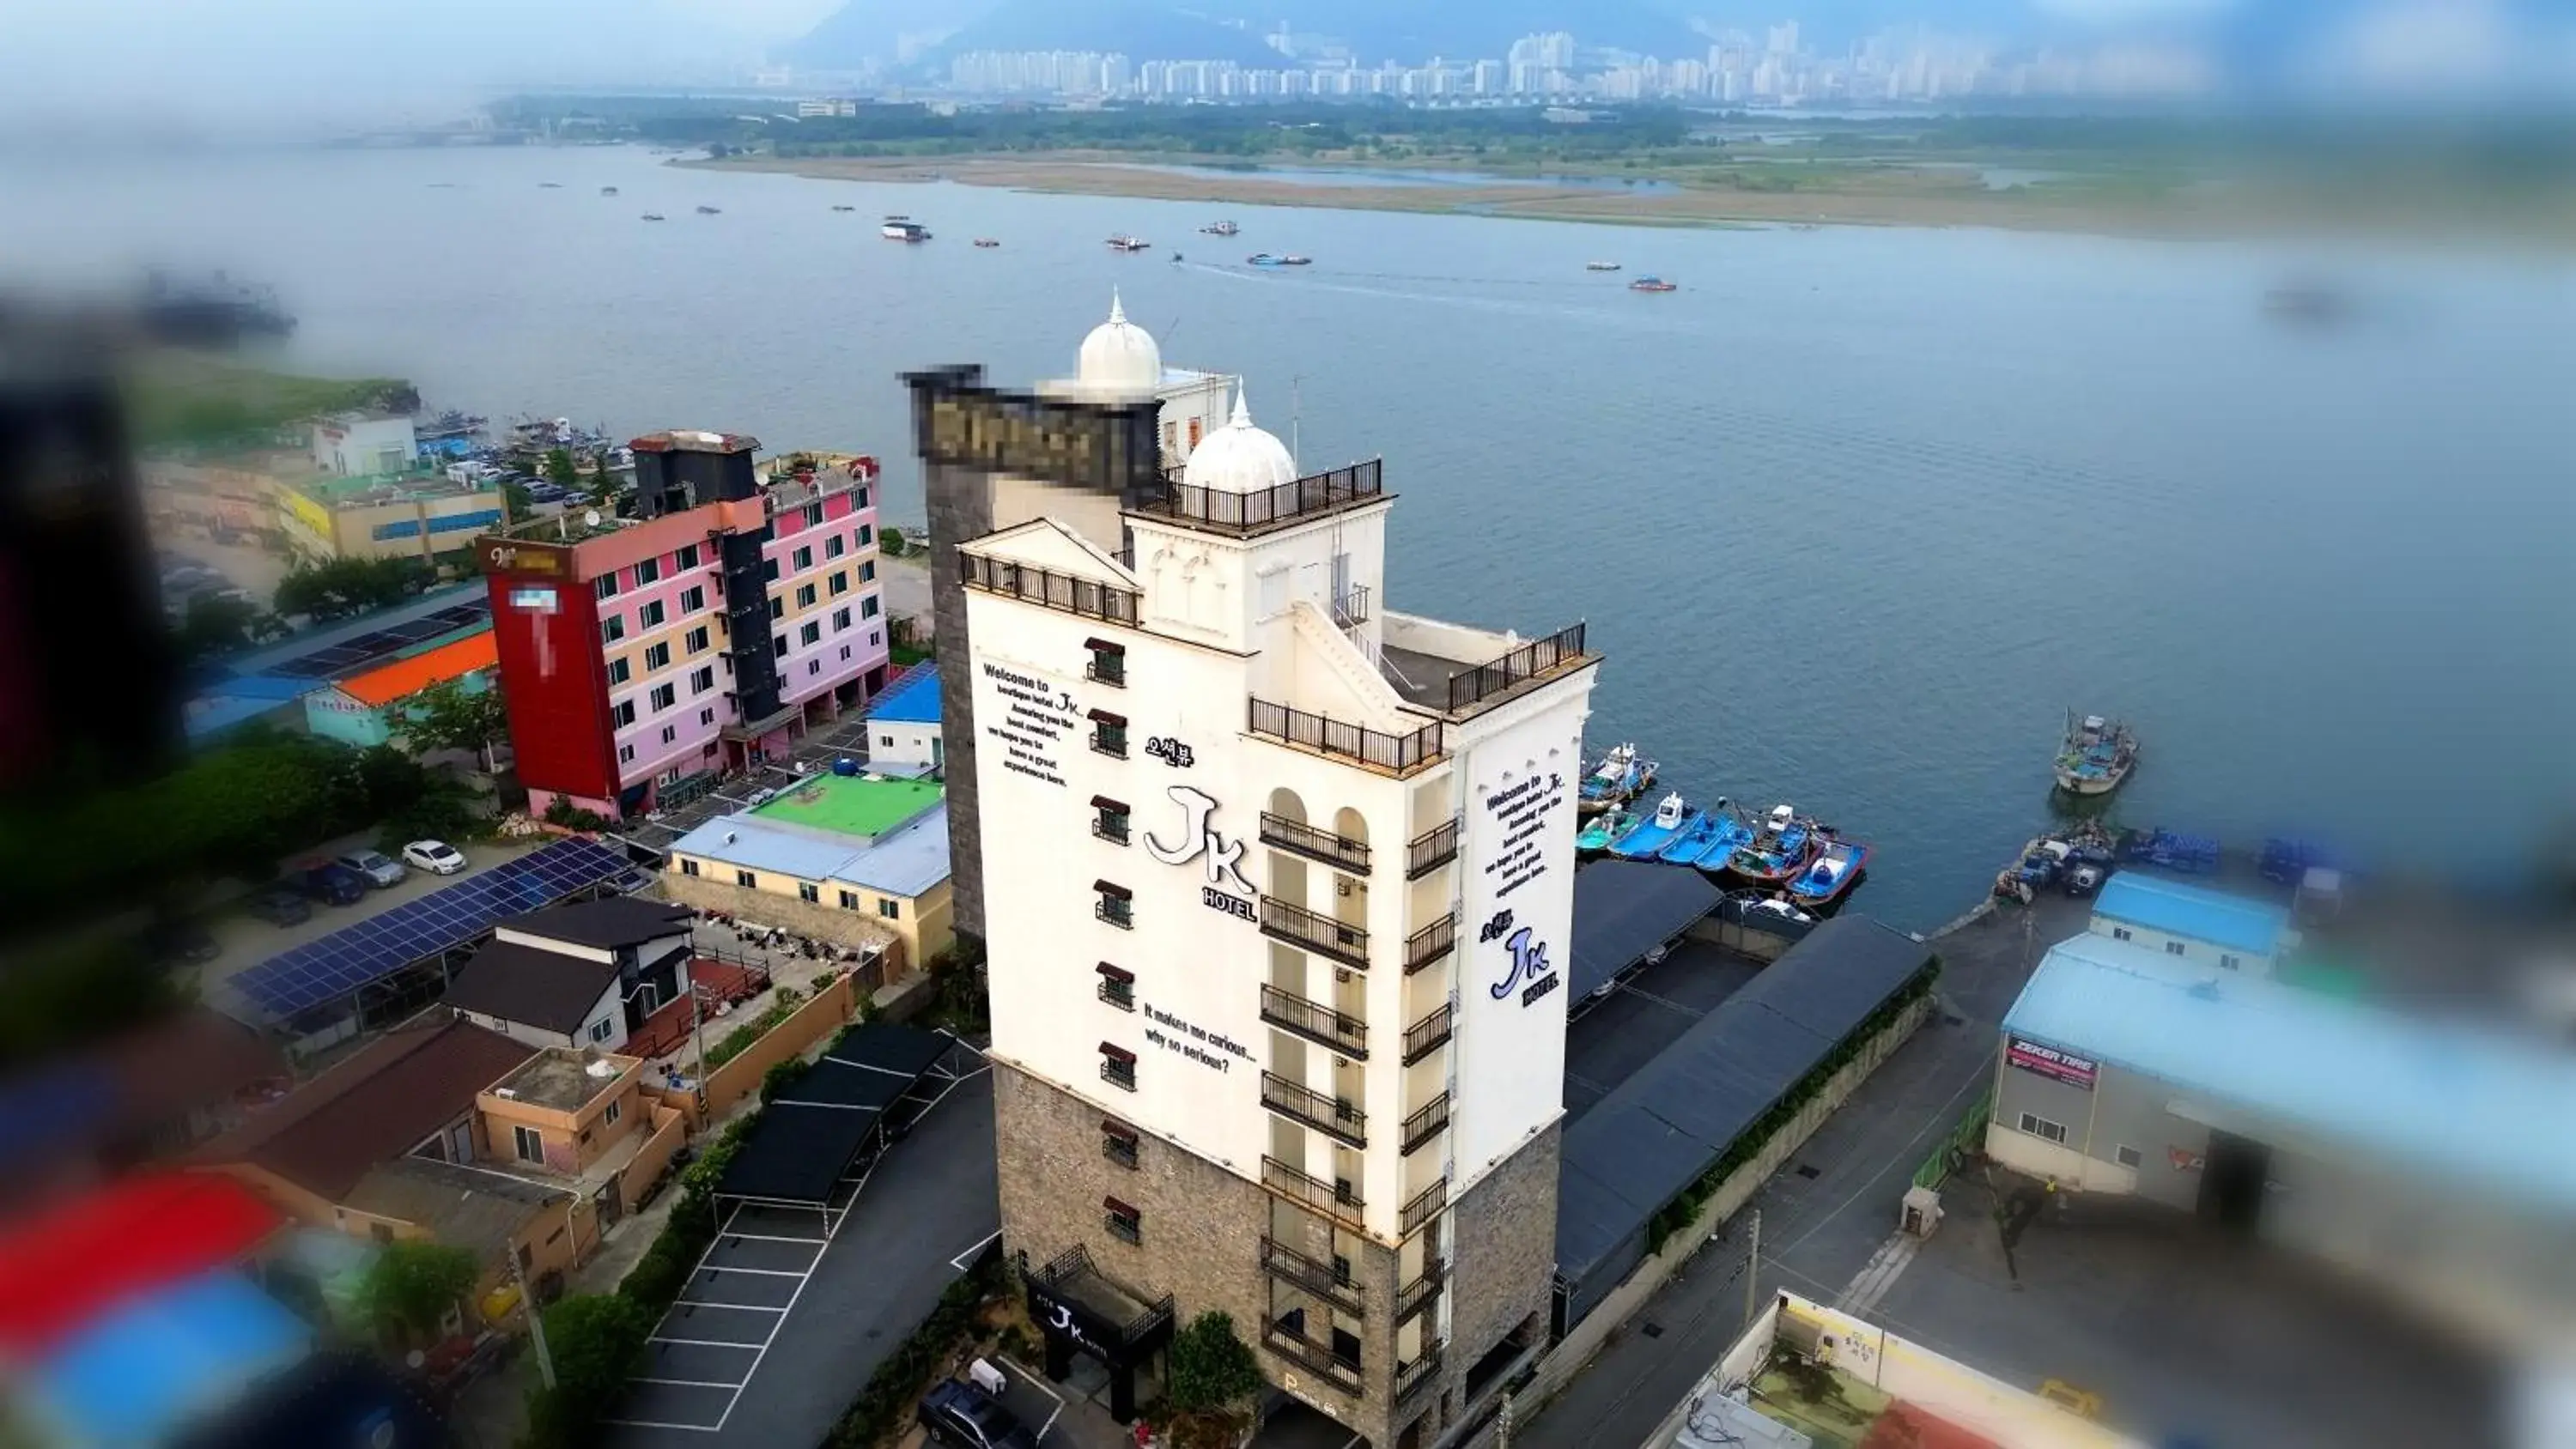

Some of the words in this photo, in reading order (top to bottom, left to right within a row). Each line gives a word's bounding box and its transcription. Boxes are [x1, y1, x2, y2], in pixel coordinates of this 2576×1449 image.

[983, 663, 1035, 689] Welcome
[1036, 678, 1049, 693] to
[1060, 716, 1074, 730] the
[1531, 775, 1542, 789] to
[1201, 885, 1258, 924] HOTEL
[1145, 1003, 1153, 1019] It
[1154, 1009, 1189, 1034] makes
[1190, 1024, 1206, 1041] me
[1145, 1028, 1167, 1050] why
[1168, 1039, 1181, 1053] so
[1183, 1044, 1230, 1074] serious?
